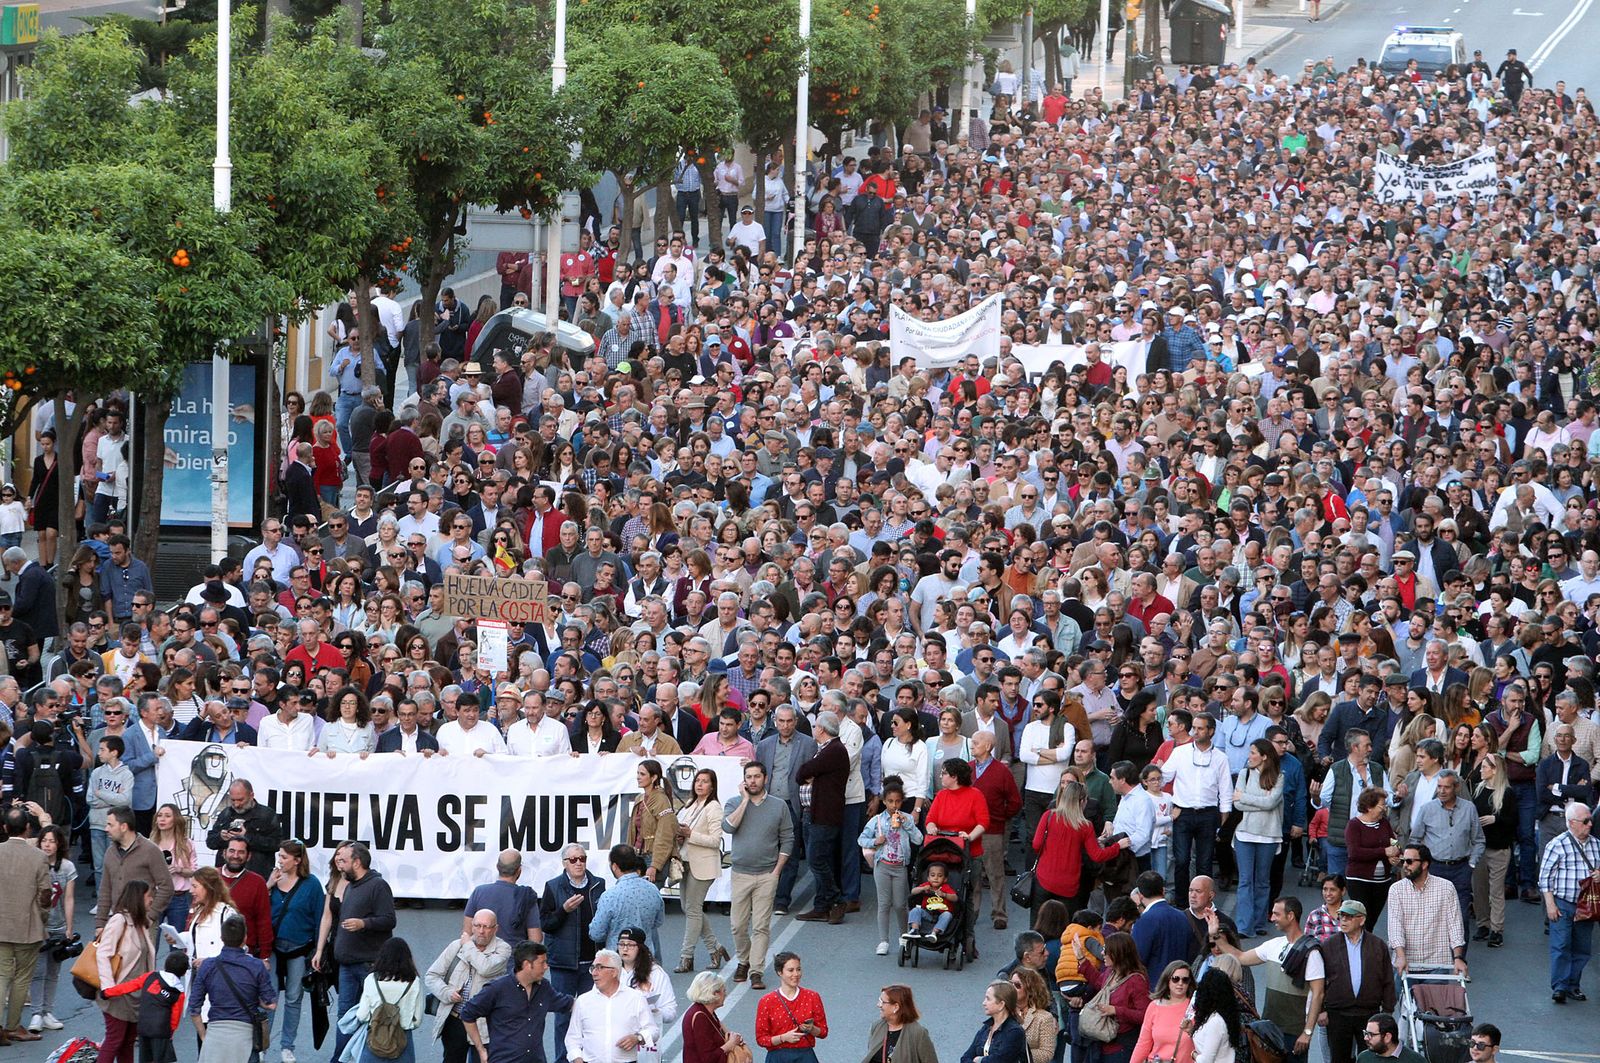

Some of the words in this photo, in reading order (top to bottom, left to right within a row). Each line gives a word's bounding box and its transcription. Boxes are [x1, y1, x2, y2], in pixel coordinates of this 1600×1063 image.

[202, 398, 234, 415] hs
[164, 424, 238, 446] mirao
[448, 576, 499, 598] HUELVA
[502, 582, 544, 600] CADIZ
[448, 596, 476, 616] POR
[480, 598, 498, 618] LA
[500, 600, 544, 622] COSTA
[268, 789, 424, 852] HUELVA
[436, 794, 488, 852] SE
